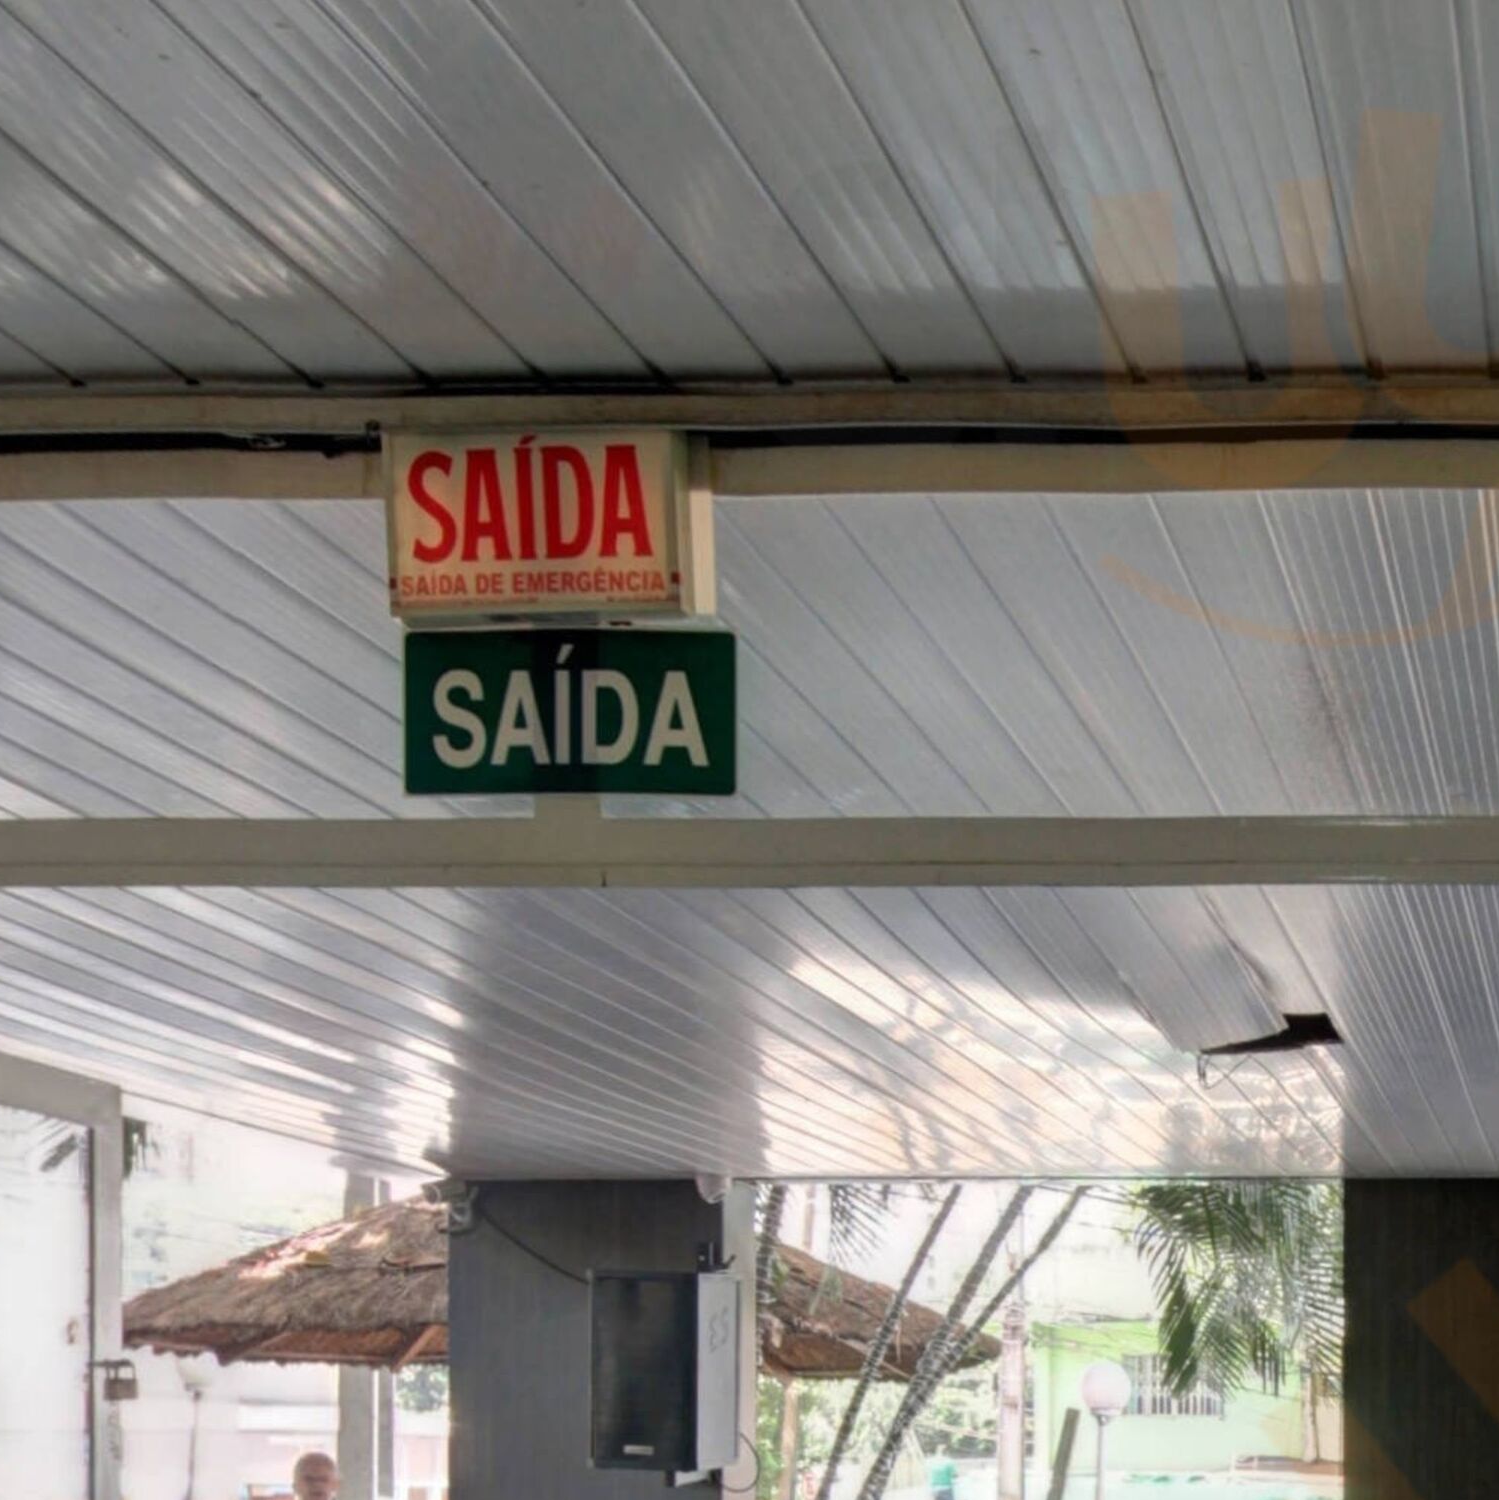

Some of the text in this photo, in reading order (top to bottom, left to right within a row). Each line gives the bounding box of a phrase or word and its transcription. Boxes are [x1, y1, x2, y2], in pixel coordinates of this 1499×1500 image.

[407, 434, 654, 563] SAÍDA
[400, 566, 666, 597] SAÍDA DE EMERGÊNCIA
[432, 643, 710, 769] SAÍDA
